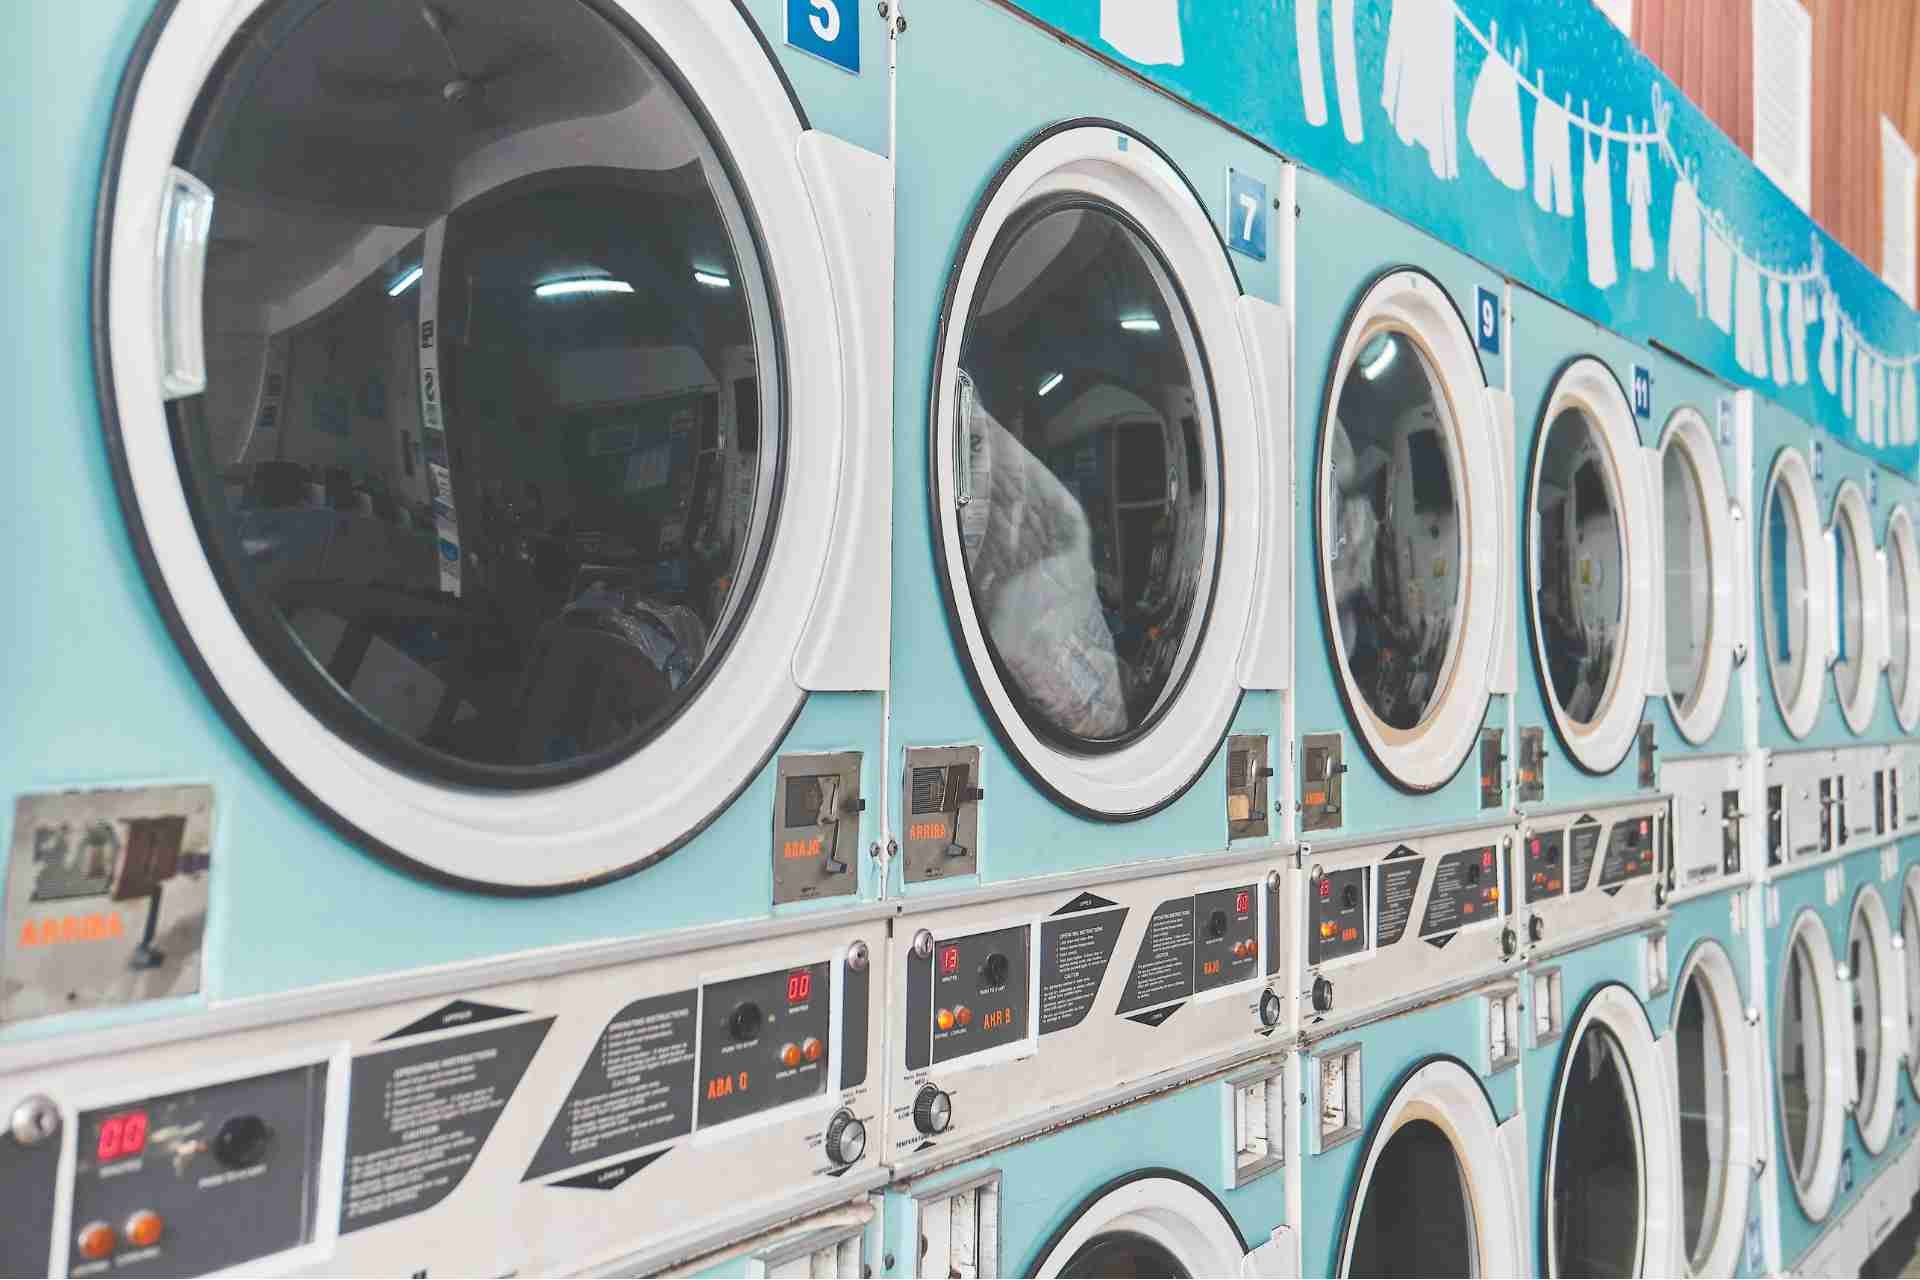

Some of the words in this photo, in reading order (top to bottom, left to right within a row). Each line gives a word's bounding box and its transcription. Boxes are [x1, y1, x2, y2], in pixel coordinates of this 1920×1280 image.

[1240, 193, 1257, 240] 7
[1483, 299, 1495, 338] 9
[1635, 377, 1648, 409] 11
[788, 974, 810, 1000] 00
[98, 1112, 148, 1161] 00
